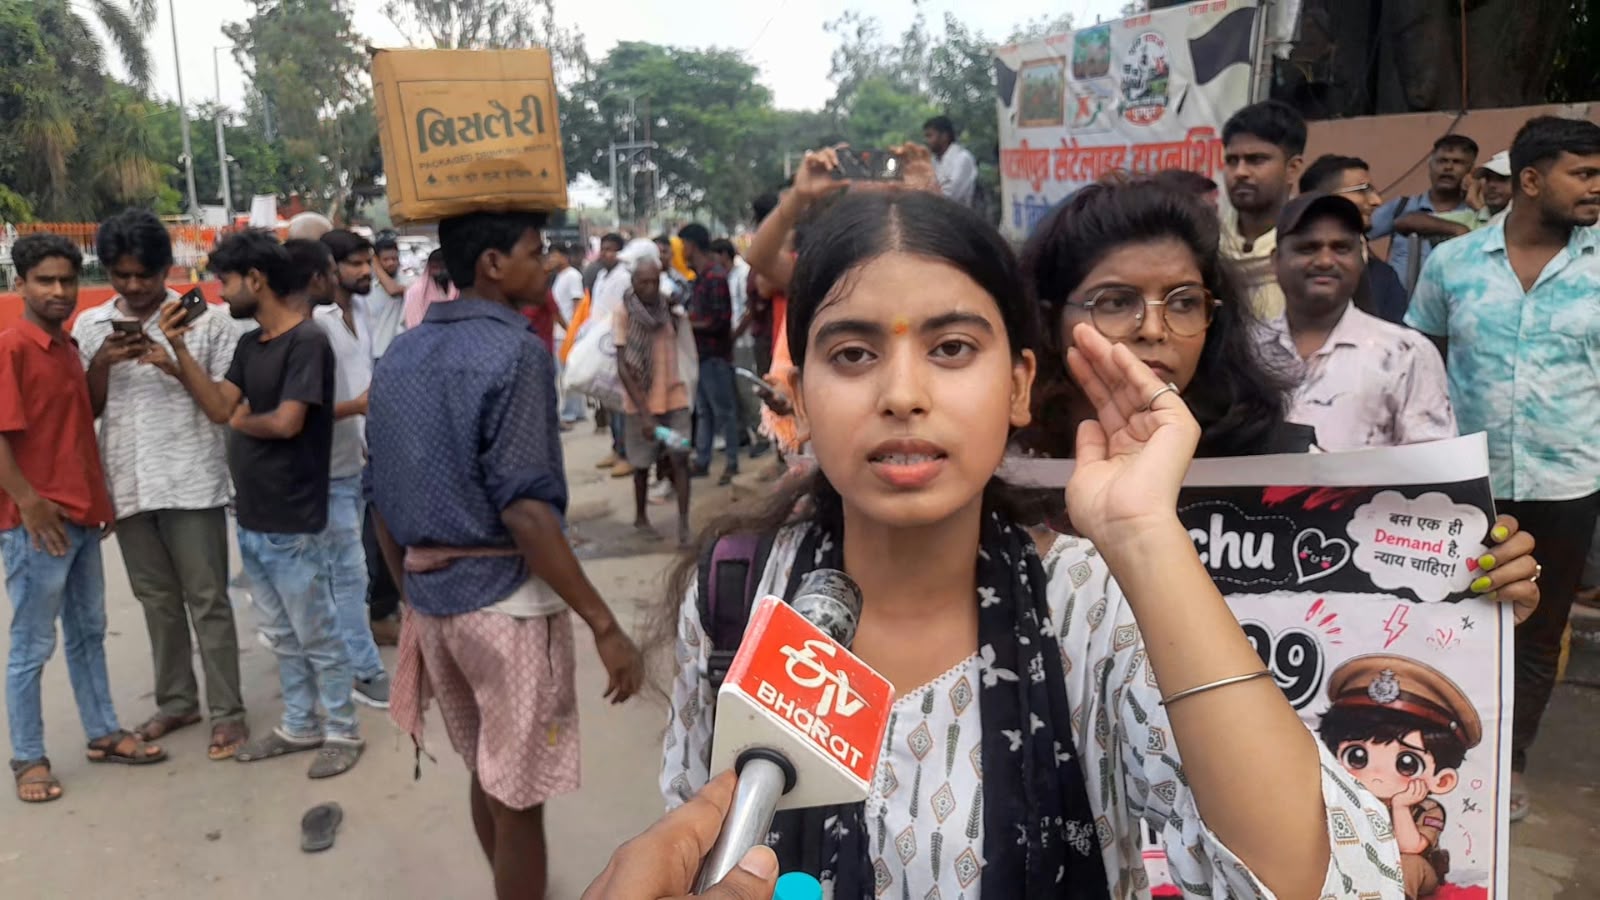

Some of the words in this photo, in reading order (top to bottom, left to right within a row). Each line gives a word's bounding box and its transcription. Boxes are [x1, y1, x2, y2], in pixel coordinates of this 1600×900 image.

[416, 94, 546, 153] बिसलेरी
[1389, 513, 1413, 527] बस
[1417, 517, 1442, 531] एक
[1448, 518, 1464, 536] ही
[1374, 528, 1443, 554] Demand
[1374, 551, 1406, 568] न्याय
[1410, 556, 1456, 578] चाहिए!
